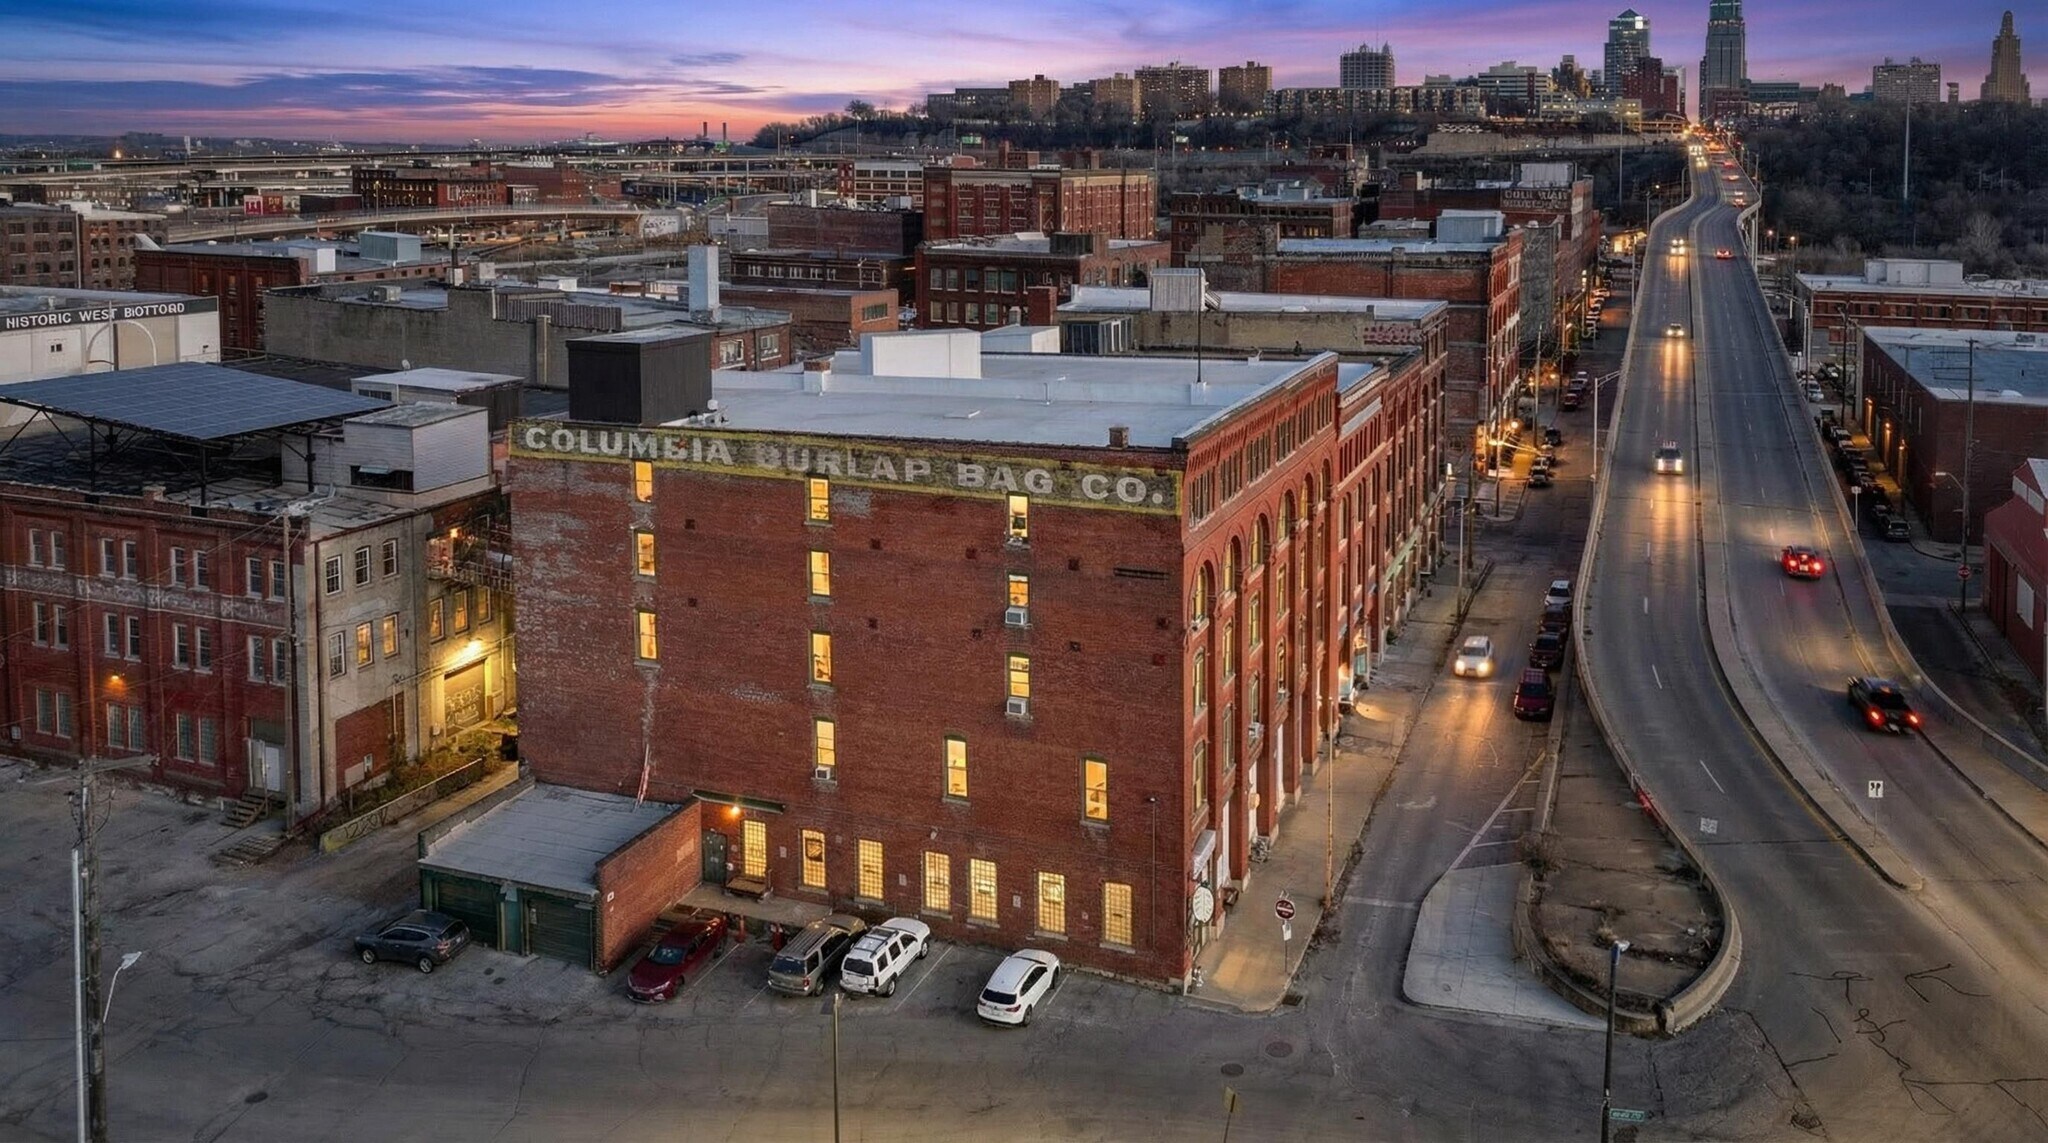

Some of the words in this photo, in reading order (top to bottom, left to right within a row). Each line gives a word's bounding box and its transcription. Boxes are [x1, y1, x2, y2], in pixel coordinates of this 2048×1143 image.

[79, 308, 117, 321] WEST
[957, 462, 1053, 494] BAG
[1081, 473, 1163, 504] CO.
